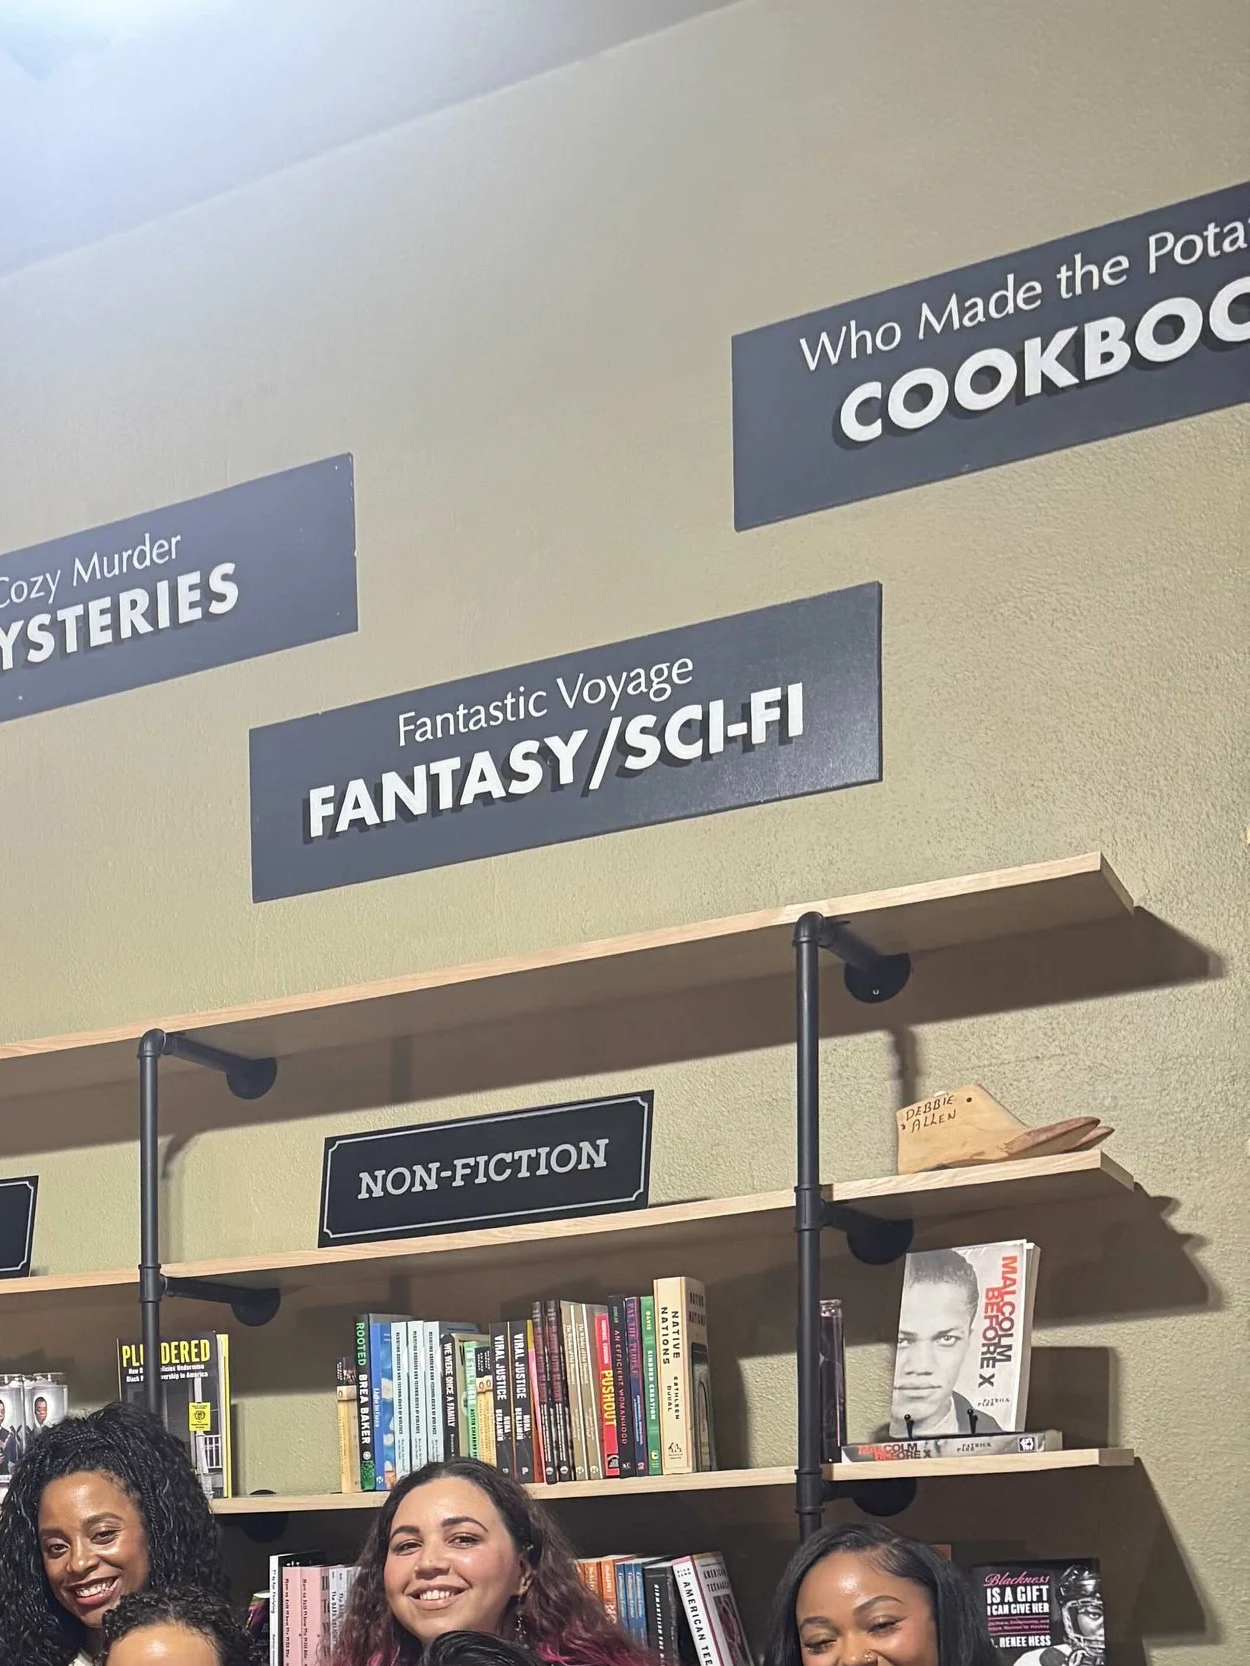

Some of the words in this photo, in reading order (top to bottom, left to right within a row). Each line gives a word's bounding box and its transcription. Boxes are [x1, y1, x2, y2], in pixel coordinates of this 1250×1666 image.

[799, 320, 901, 371] Who
[919, 273, 1042, 340] Made
[1057, 253, 1129, 299] the
[1149, 218, 1250, 273] Pota
[73, 532, 182, 587] Murder
[397, 687, 548, 747] Fantastic
[556, 656, 694, 709] Voyage
[309, 682, 804, 838] FANTASY/SCI-FI
[906, 1094, 954, 1121] DEBBIE
[911, 1108, 956, 1133] ALLEN
[358, 1139, 610, 1201] NON-FICTION
[980, 1286, 1003, 1369] BEFORE
[995, 1256, 1018, 1363] MALCOLM
[122, 1339, 210, 1367] PLDERED
[356, 1322, 367, 1366] ROOTED
[444, 1343, 452, 1354] WE
[494, 1335, 504, 1361] VIRAL
[514, 1333, 524, 1359] VIRAL
[614, 1330, 619, 1341] AN
[661, 1307, 670, 1364] NATIONS
[672, 1311, 680, 1358] NATIVE
[444, 1355, 453, 1375] WERE
[496, 1363, 507, 1400] JUSTICE
[515, 1362, 526, 1399] JUSTICE
[615, 1344, 624, 1386] EFFICIENT
[978, 1373, 995, 1388] X
[358, 1374, 369, 1404] BREA
[445, 1377, 454, 1394] ONCE
[601, 1369, 617, 1426] PUSHOUT
[360, 1407, 371, 1444] BAKER
[447, 1403, 455, 1427] FAMILY
[618, 1390, 628, 1444] WOMANHOOD
[923, 1450, 931, 1458] X
[984, 1571, 1050, 1586] Blackness
[987, 1588, 1001, 1604] IS
[1005, 1587, 1015, 1602] A
[1017, 1585, 1049, 1602] GIFT
[654, 1584, 663, 1634] DISMANTLING
[683, 1581, 706, 1641] AMERICAN
[987, 1605, 991, 1616] I
[992, 1604, 1010, 1615] CAN
[1011, 1603, 1030, 1614] GIVE
[1032, 1602, 1050, 1613] HER
[1000, 1636, 1027, 1648] RENEE
[1028, 1635, 1051, 1647] HESS
